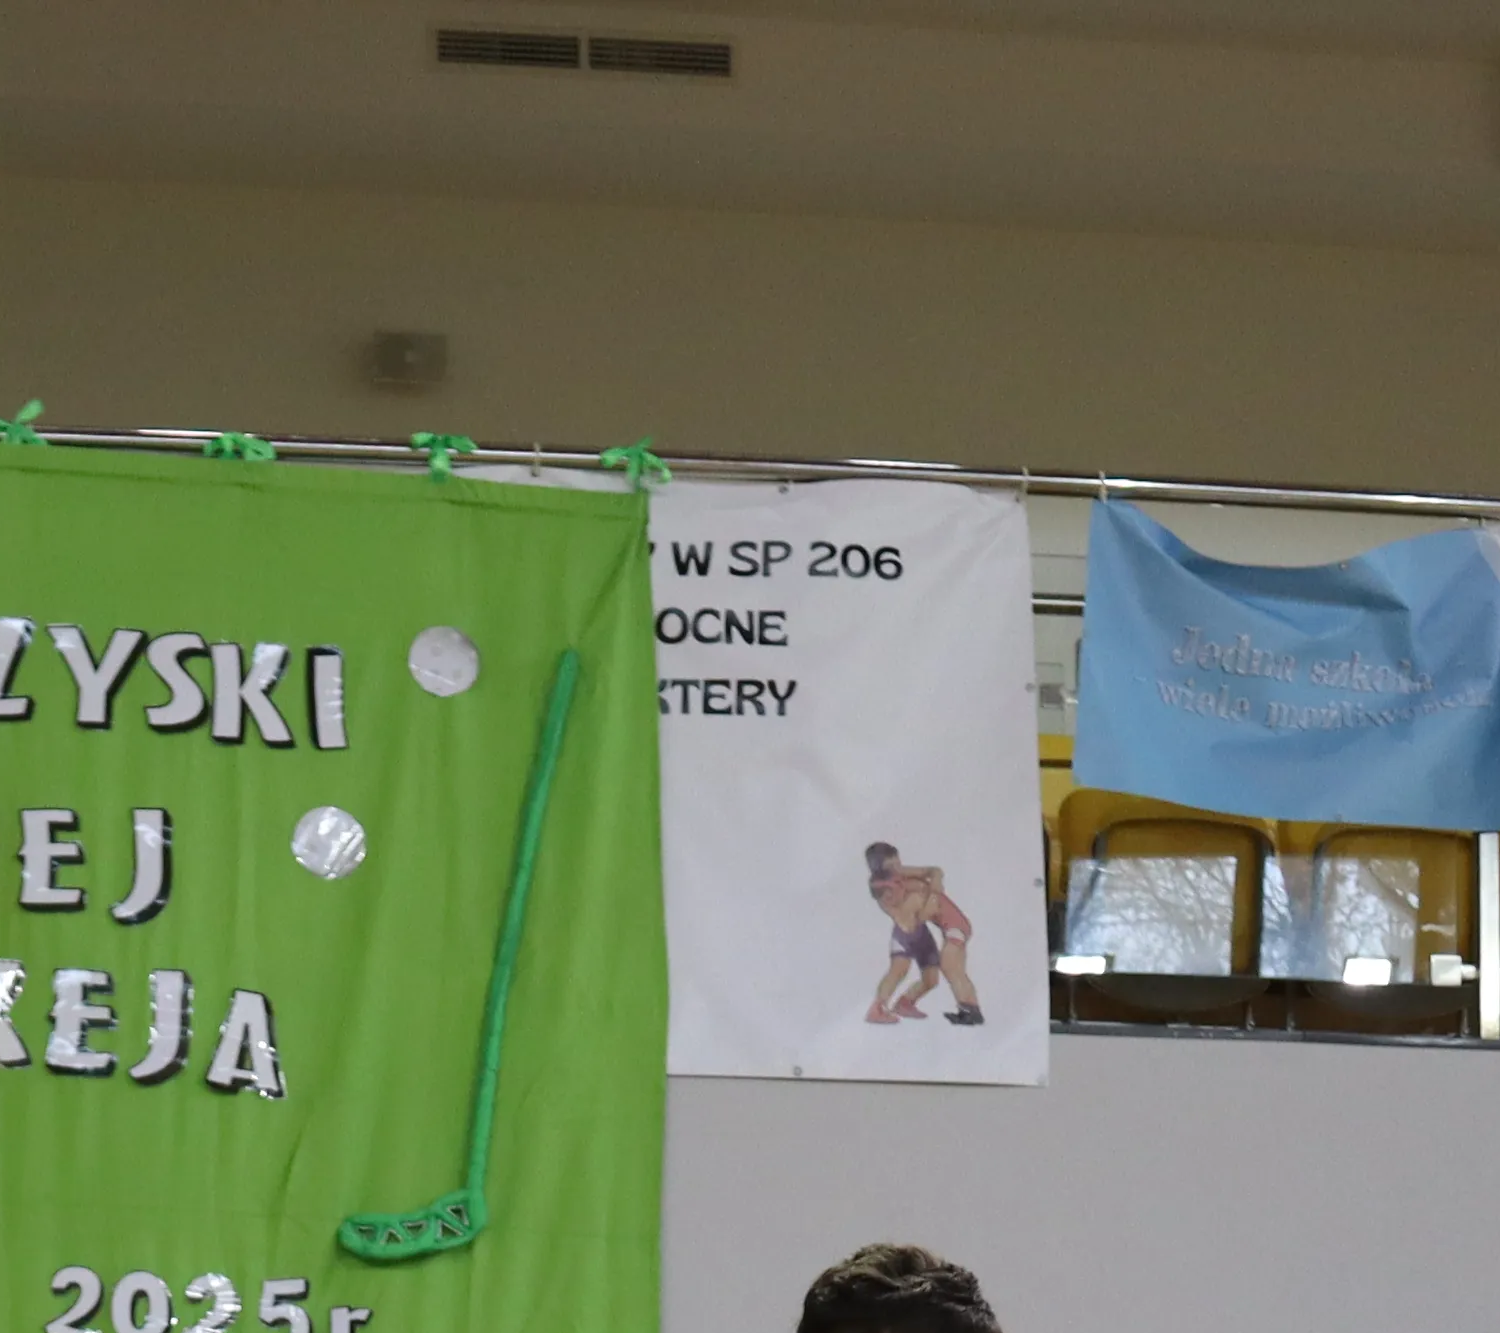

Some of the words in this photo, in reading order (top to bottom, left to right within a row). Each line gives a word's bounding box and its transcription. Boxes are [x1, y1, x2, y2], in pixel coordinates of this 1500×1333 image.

[673, 541, 713, 578] W
[728, 541, 793, 578] SP
[808, 541, 905, 581] 206
[654, 607, 788, 647] OCNE
[1171, 625, 1297, 684] Jedna
